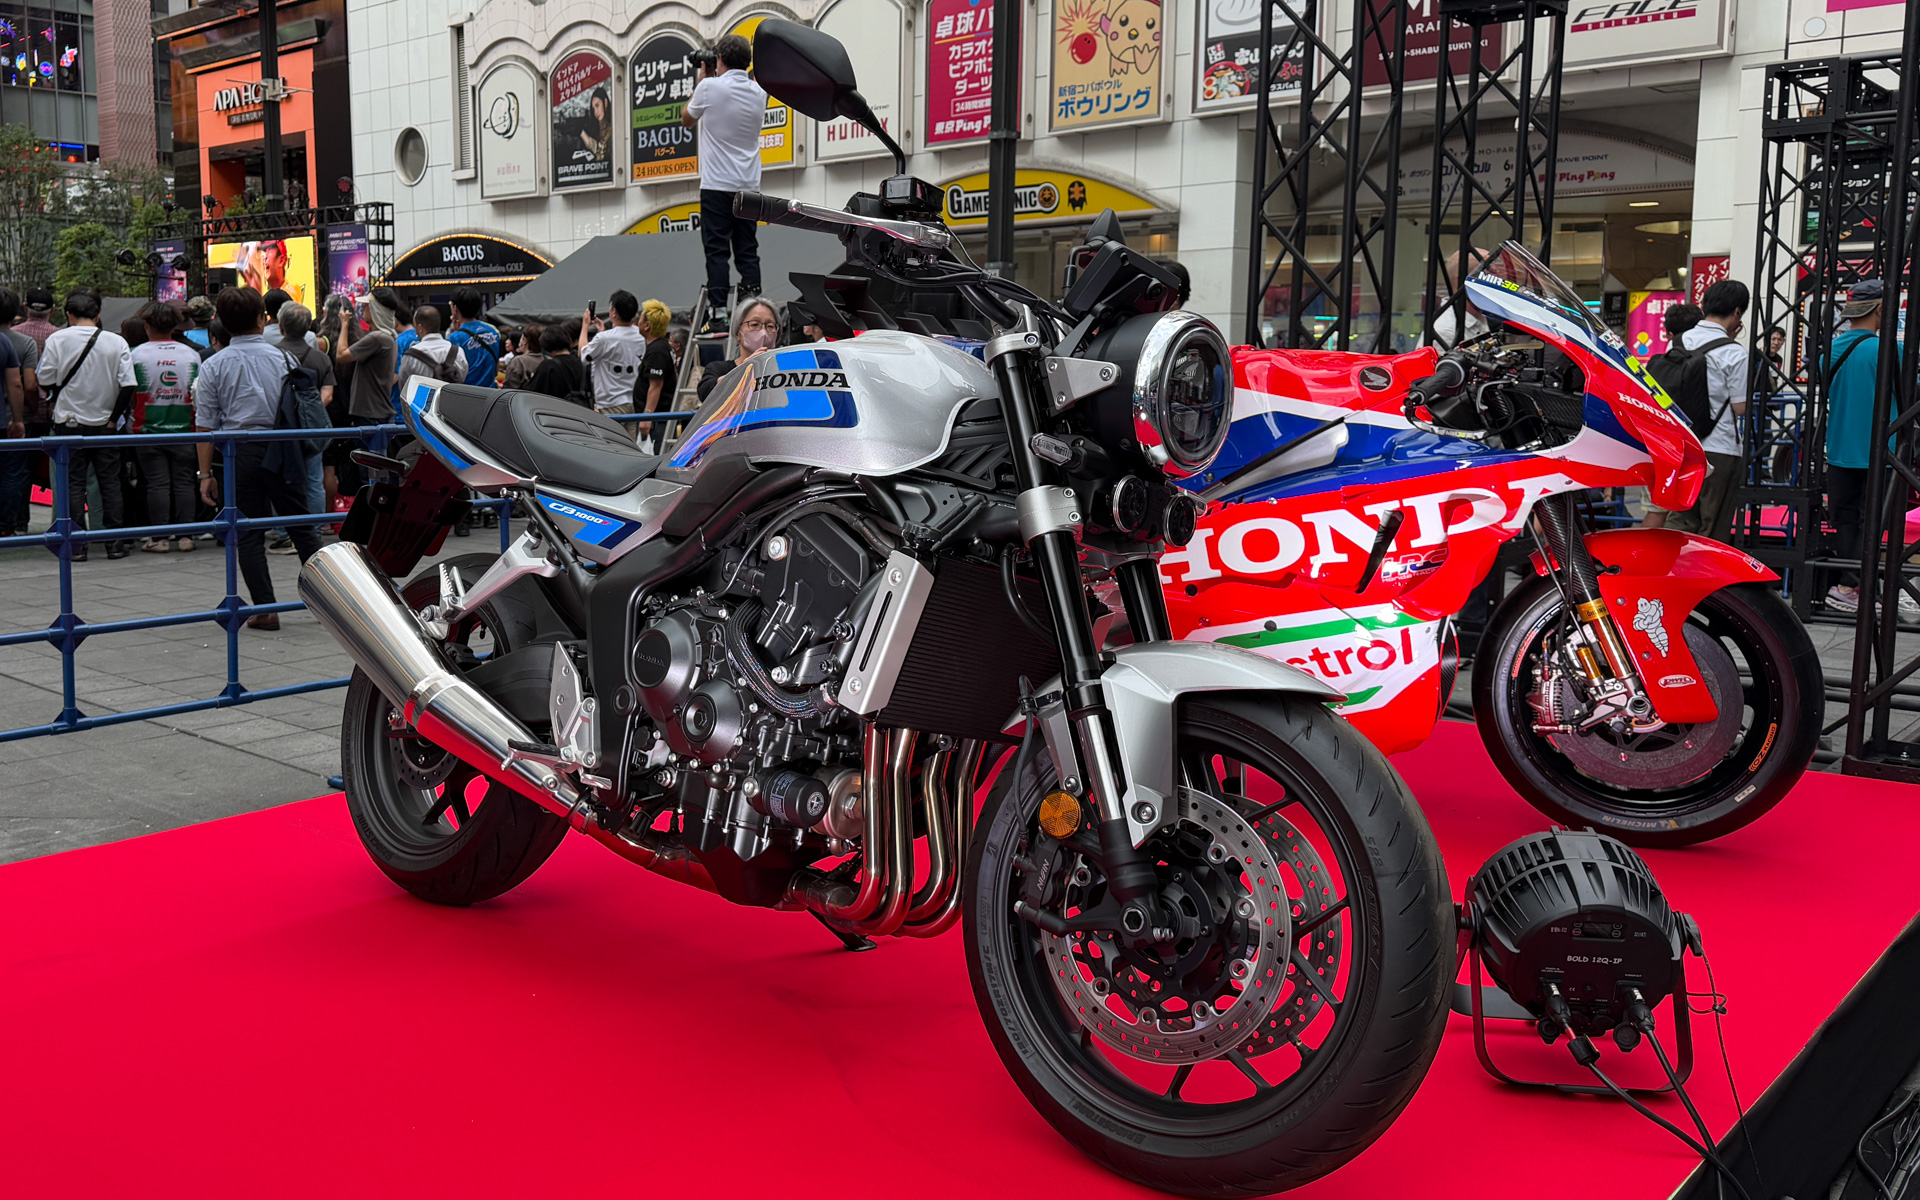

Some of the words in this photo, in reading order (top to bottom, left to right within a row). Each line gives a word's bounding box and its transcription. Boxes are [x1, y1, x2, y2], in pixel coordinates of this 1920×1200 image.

[1588, 11, 1678, 30] SHINJUKU
[1448, 39, 1488, 51] SUKIYKI
[213, 87, 240, 111] APA
[241, 77, 289, 106] HOL
[635, 82, 667, 105] ダーツ
[669, 76, 694, 99] 卓球
[955, 75, 992, 95] ダーツ
[1058, 86, 1151, 118] ボウリング
[764, 110, 784, 125] ANIC
[935, 120, 954, 134] 東京
[956, 119, 982, 133] Ping
[638, 125, 692, 148] BAGUS
[827, 117, 889, 142] HUMX
[655, 146, 676, 157] バグース
[1557, 155, 1580, 163] RAVE
[558, 164, 583, 175] BRAVE
[585, 161, 609, 172] POINT
[637, 166, 646, 177] 24
[647, 163, 673, 176] HOURS
[674, 161, 695, 173] OPEN
[1559, 172, 1584, 183] Ping
[1014, 190, 1037, 210] NIC
[442, 244, 484, 262] BAGUS
[506, 262, 524, 273] GOLF
[1706, 264, 1717, 287] サバ
[1720, 259, 1729, 281] イン
[753, 371, 851, 393] HONDA
[1617, 391, 1677, 427] HONDA
[1161, 472, 1592, 584] HONDA
[1285, 626, 1414, 678] strol
[1602, 815, 1658, 829] MICHELIN
[1566, 955, 1589, 963] BOLD
